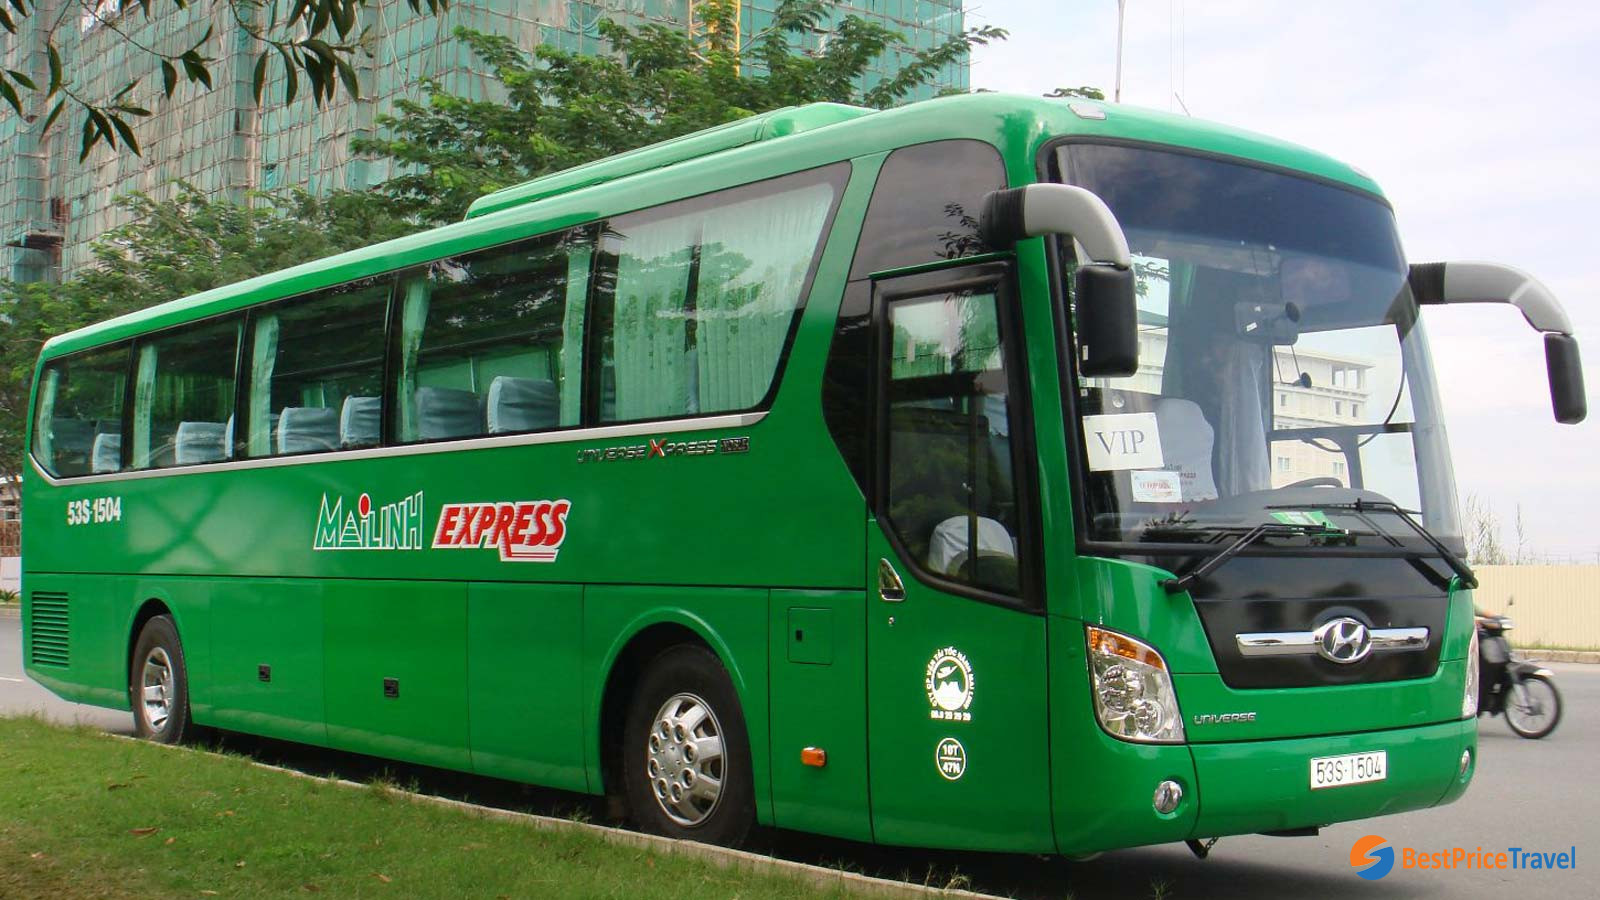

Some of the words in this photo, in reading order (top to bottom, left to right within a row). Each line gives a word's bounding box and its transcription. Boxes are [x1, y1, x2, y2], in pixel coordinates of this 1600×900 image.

[1095, 430, 1144, 455] VIP
[431, 499, 571, 562] EXPRESS
[1193, 712, 1257, 724] UNIVERSE
